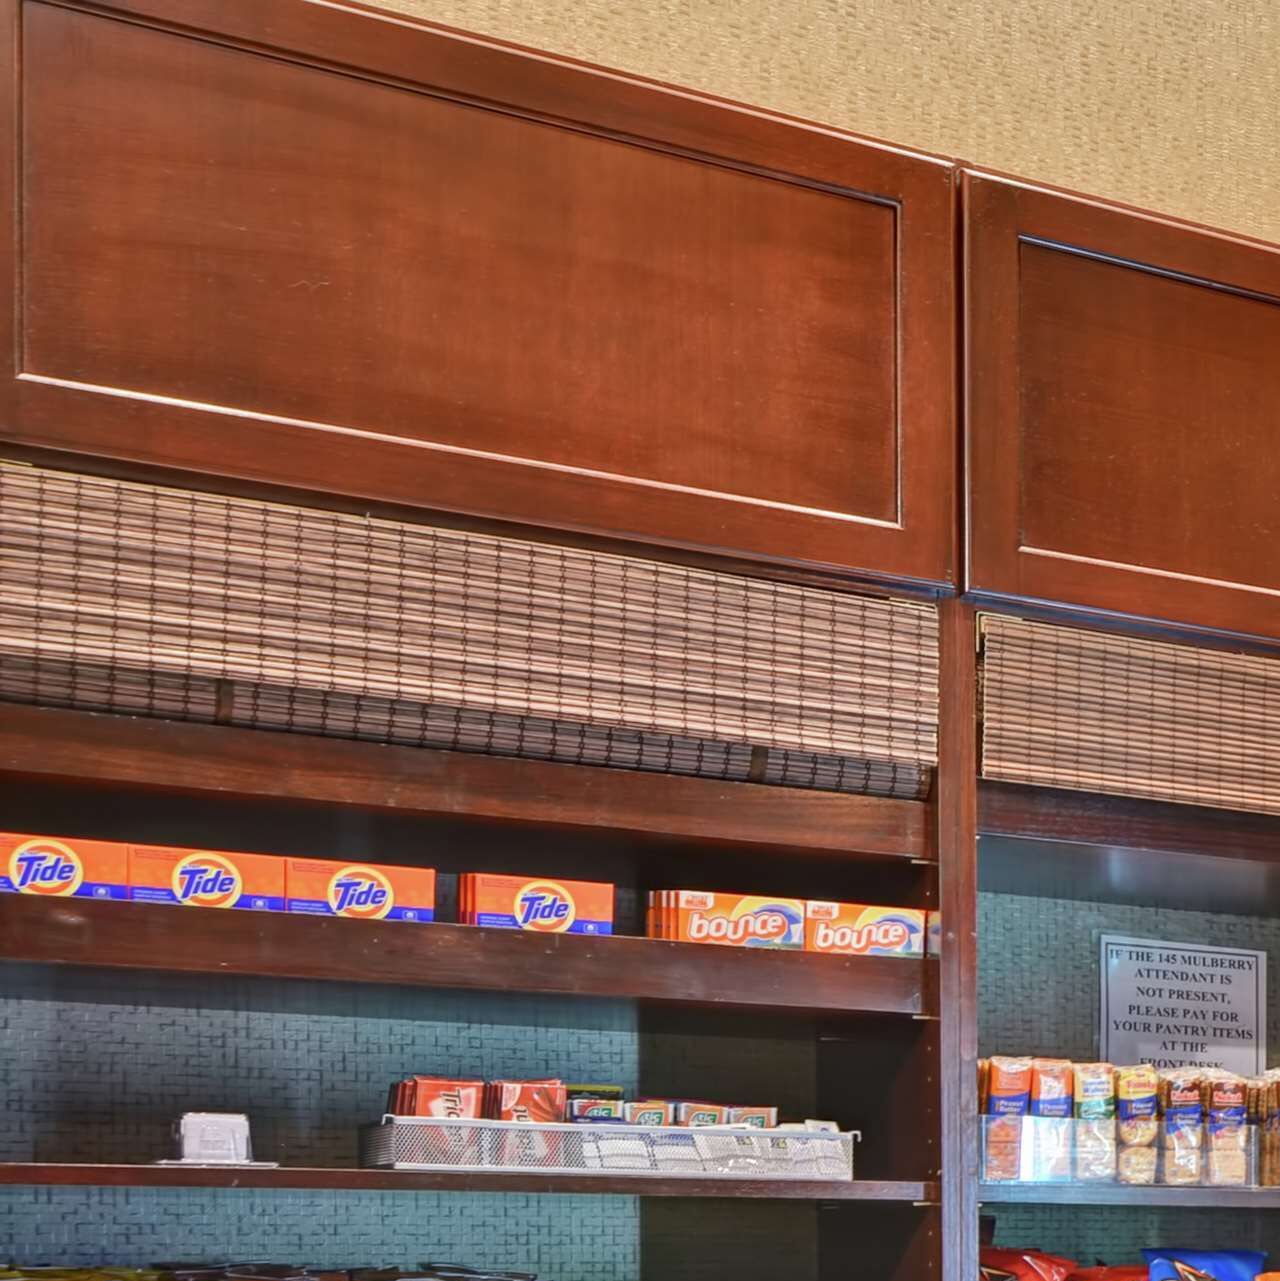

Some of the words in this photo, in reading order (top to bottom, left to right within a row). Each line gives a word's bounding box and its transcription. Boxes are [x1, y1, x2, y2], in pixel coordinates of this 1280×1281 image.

[14, 851, 77, 887] Tide
[177, 865, 237, 900] Tide
[331, 879, 388, 914] Tide
[519, 893, 572, 924] Tide
[688, 912, 785, 942] bounce
[815, 920, 908, 949] bounce
[1109, 948, 1122, 959] IF
[1127, 950, 1154, 963] THE
[1158, 952, 1177, 965] 145
[1180, 954, 1254, 971] MULBERRY
[1134, 968, 1216, 984] ATTENDANT
[1220, 974, 1232, 985] IS
[1136, 986, 1164, 998] NOT
[1168, 988, 1231, 1004] PRESENT,
[1128, 1004, 1179, 1019] PLEASE
[1183, 1009, 1208, 1021] PAY
[1212, 1010, 1239, 1023] FOR
[1113, 1020, 1151, 1033] YOUR
[1155, 1023, 1208, 1037] PANTRY
[1212, 1027, 1253, 1040] ITEMS
[1160, 1041, 1177, 1051] AT
[1180, 1041, 1207, 1053] THE
